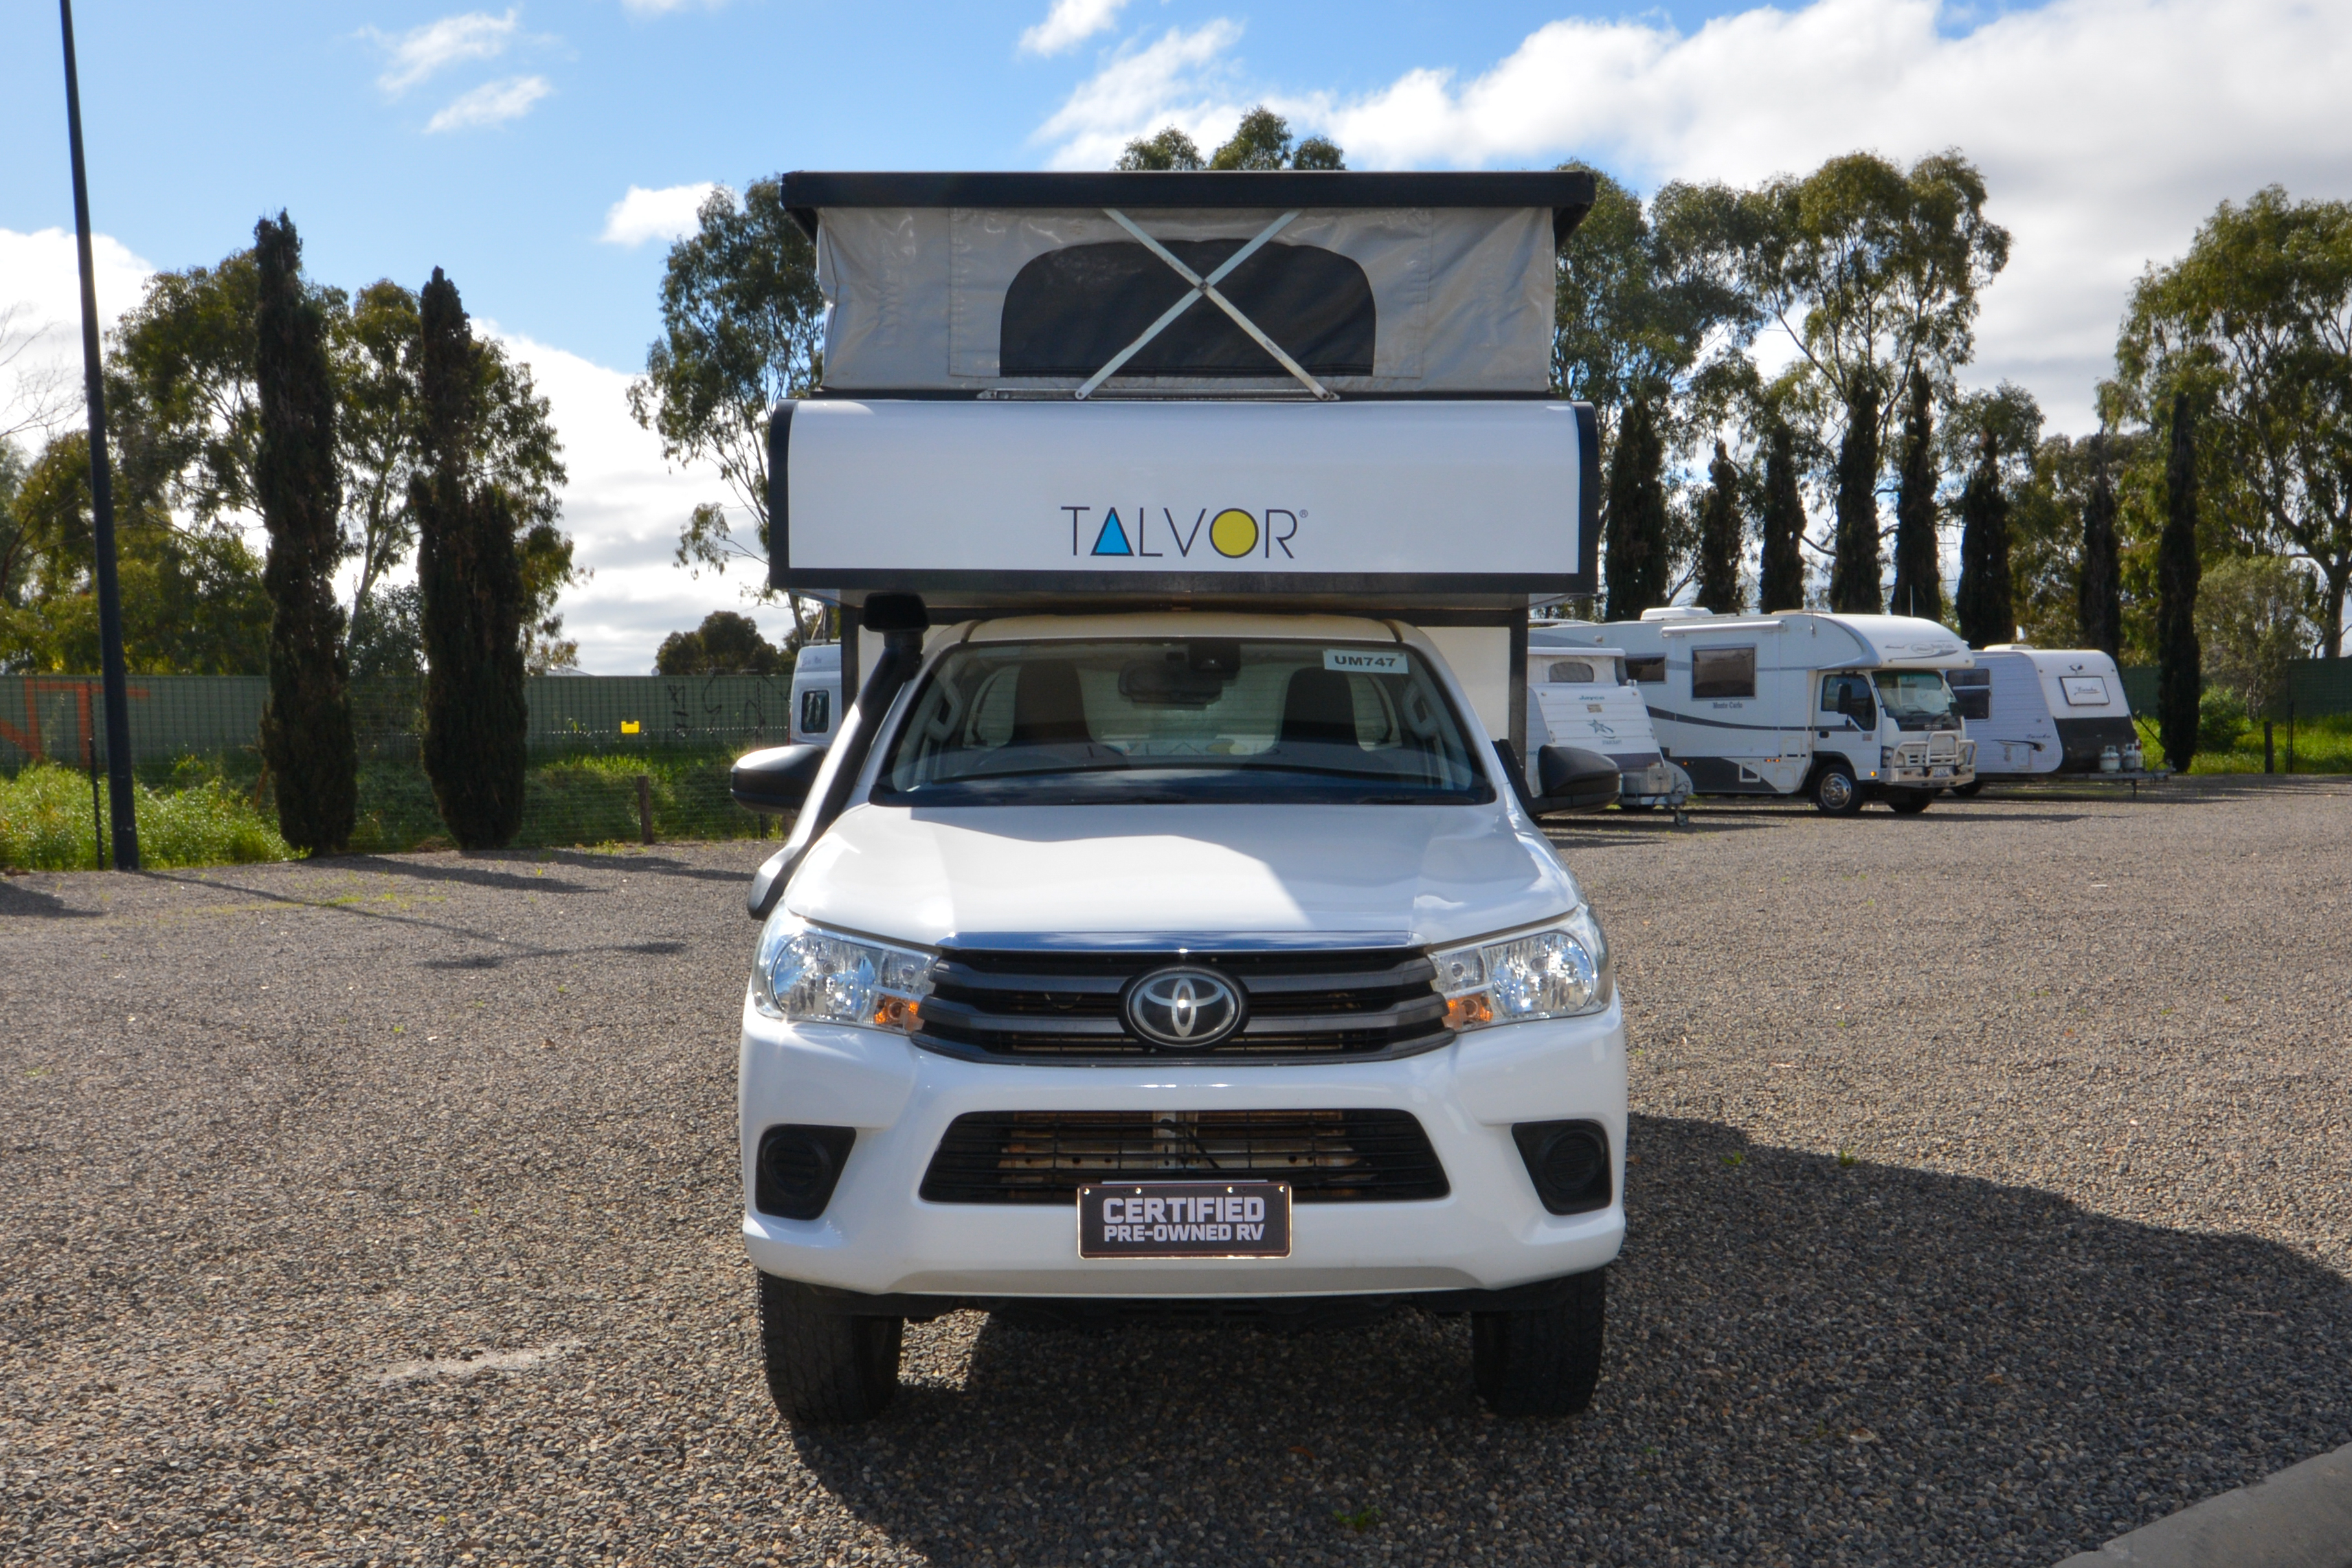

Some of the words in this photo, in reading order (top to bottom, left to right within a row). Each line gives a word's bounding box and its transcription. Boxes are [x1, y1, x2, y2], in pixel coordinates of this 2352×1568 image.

[1060, 506, 1299, 559] TALVOR
[1334, 655, 1396, 667] UM747
[1103, 1197, 1265, 1224] CERTIFIED
[1104, 1224, 1231, 1242] PRE-OWNED
[1237, 1224, 1264, 1240] RV
